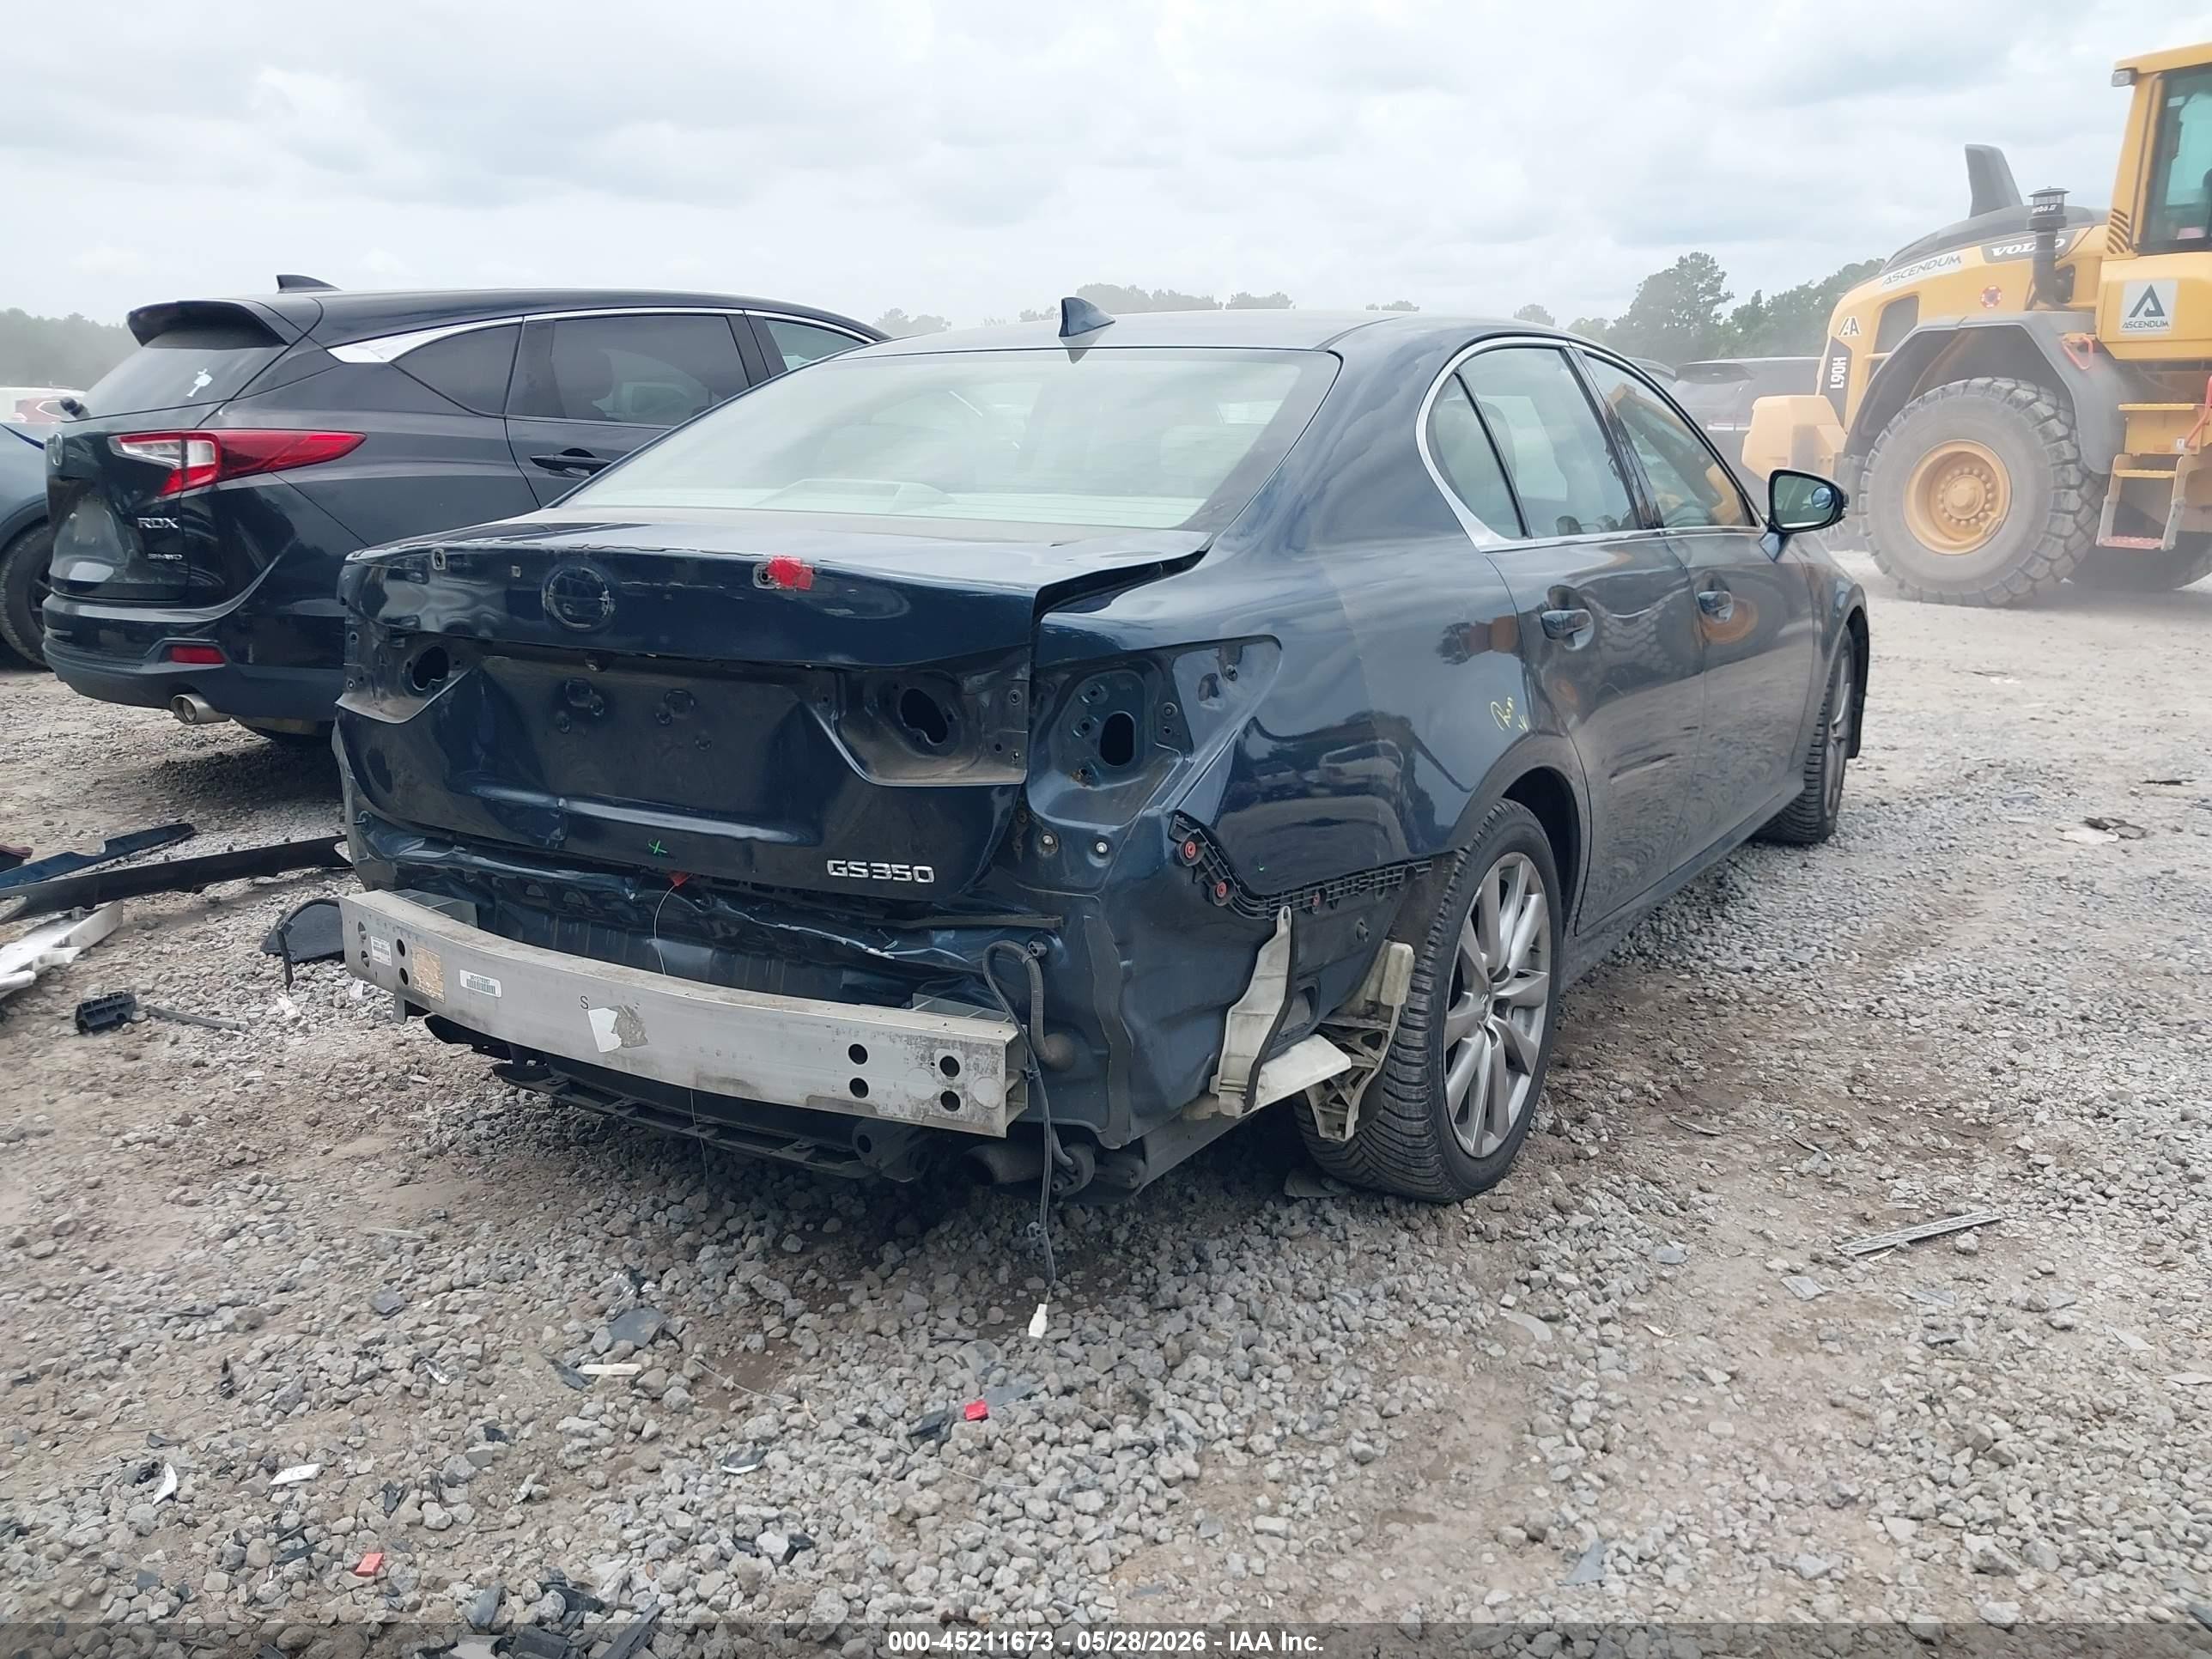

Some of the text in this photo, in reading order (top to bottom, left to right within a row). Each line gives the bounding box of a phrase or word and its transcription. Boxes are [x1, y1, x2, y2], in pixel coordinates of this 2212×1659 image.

[1991, 238, 2066, 257] VOLO
[1882, 252, 1962, 286] ASCENDUM
[2122, 320, 2171, 329] ASCENDUM
[1830, 357, 1847, 389] L90H
[137, 518, 179, 528] RDX
[580, 995, 589, 1009] S
